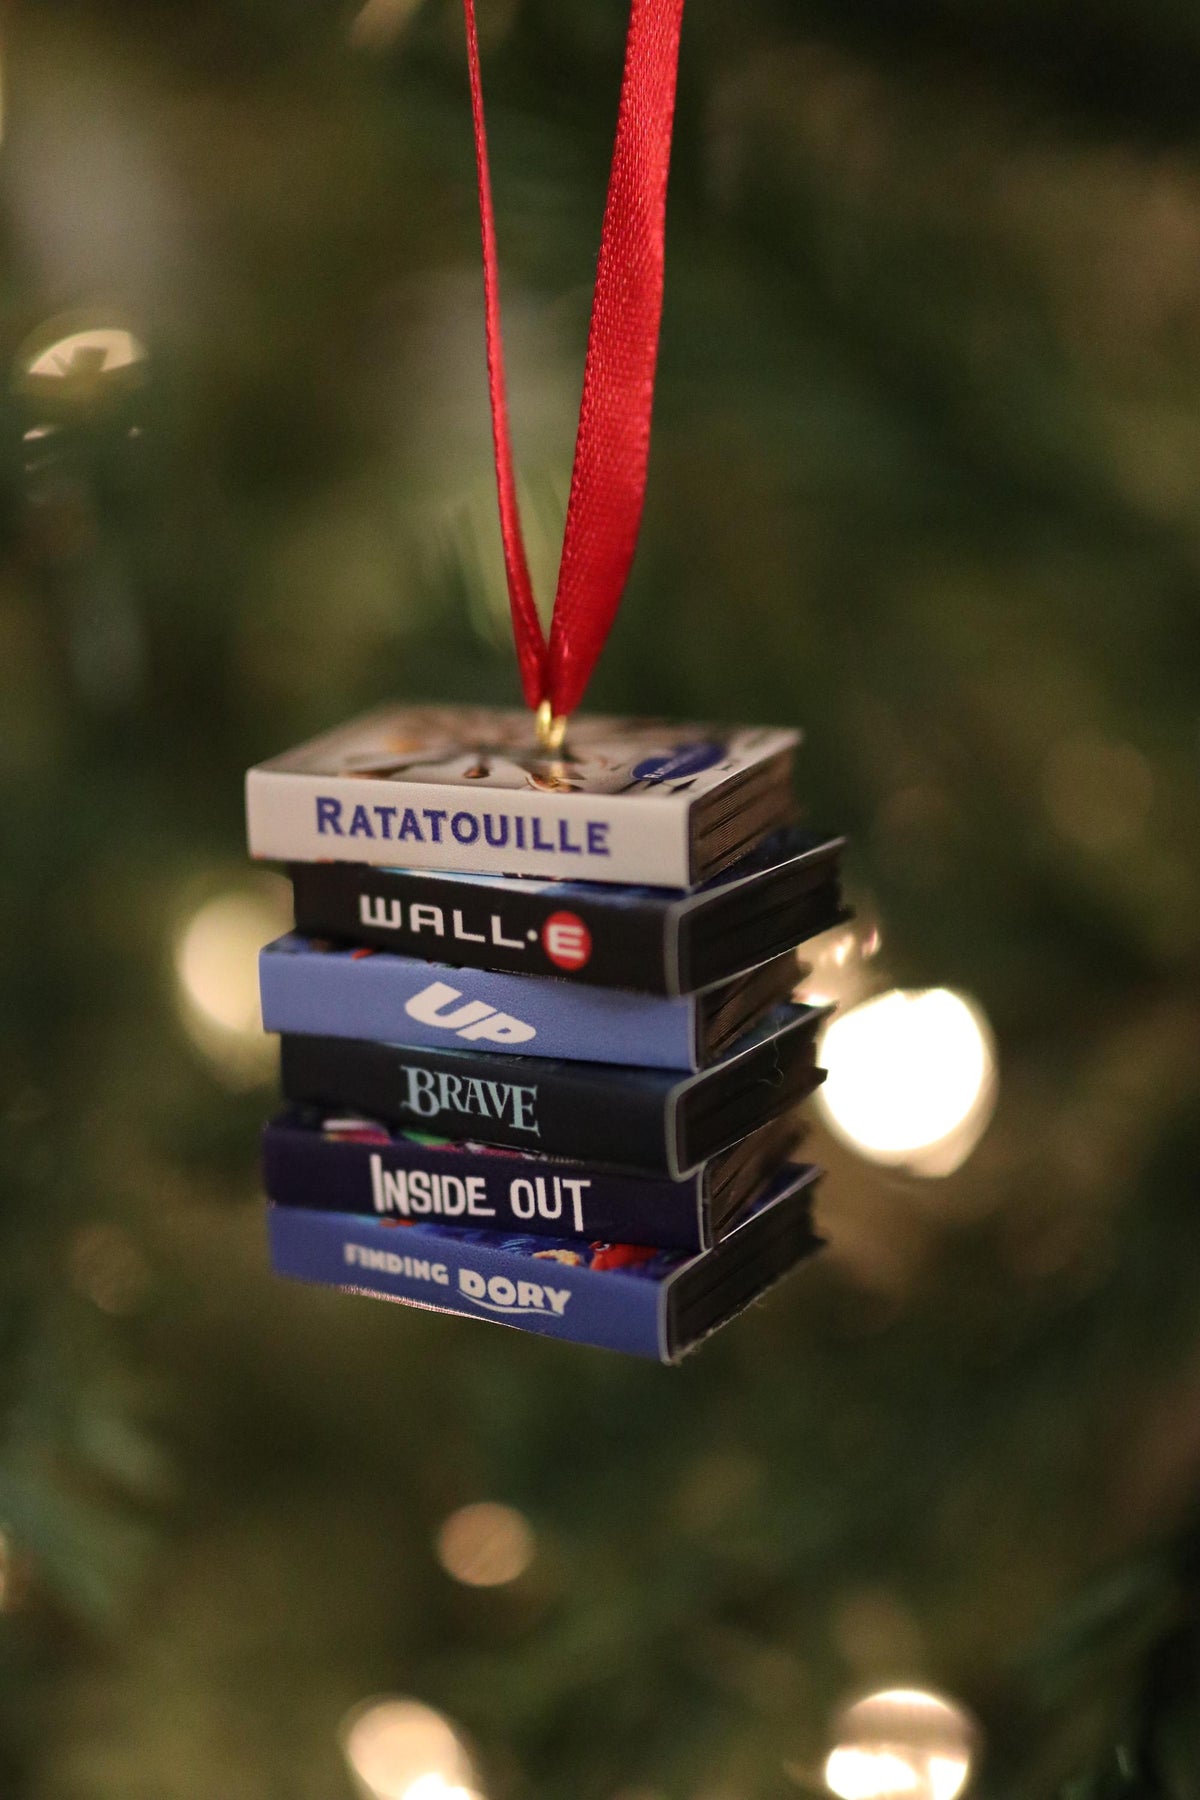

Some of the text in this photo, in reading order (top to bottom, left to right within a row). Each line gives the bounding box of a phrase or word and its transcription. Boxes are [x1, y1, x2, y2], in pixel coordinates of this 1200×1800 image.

[316, 798, 610, 856] RATATOUILLE
[405, 981, 537, 1044] UP
[401, 1066, 541, 1137] BRAVE
[370, 1154, 592, 1232] INSIDE OUT
[343, 1242, 573, 1317] FINDING DORY
